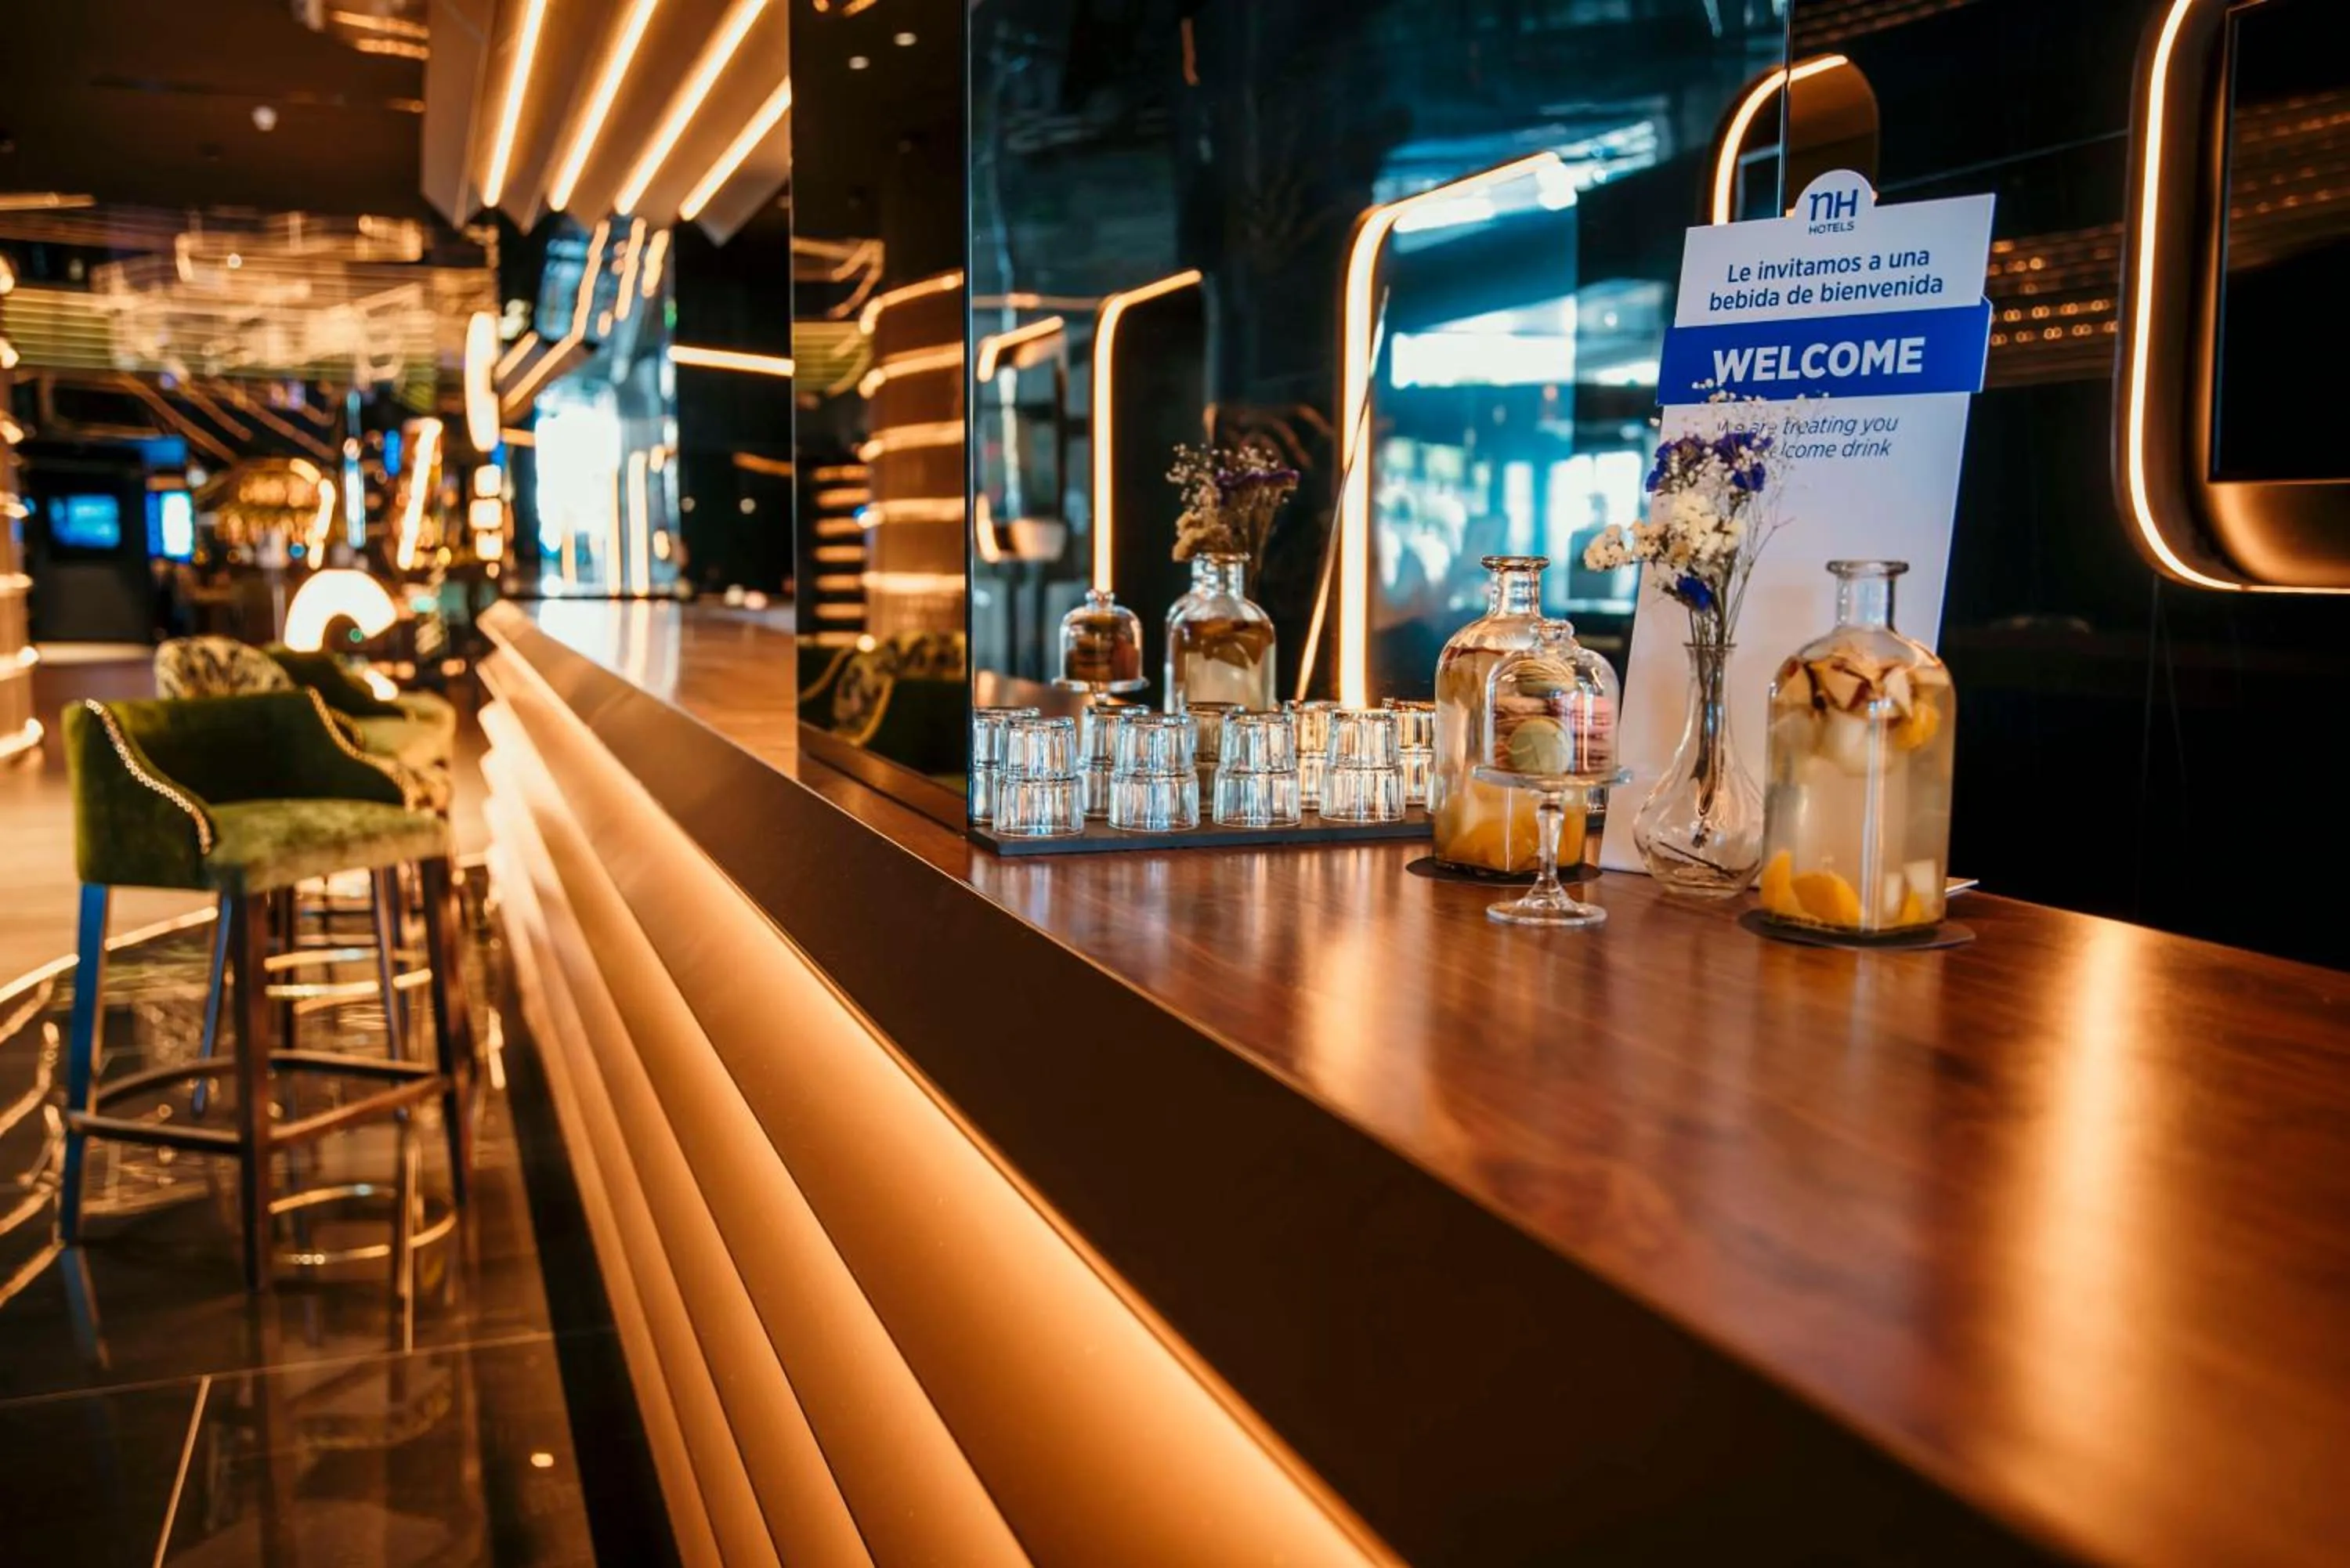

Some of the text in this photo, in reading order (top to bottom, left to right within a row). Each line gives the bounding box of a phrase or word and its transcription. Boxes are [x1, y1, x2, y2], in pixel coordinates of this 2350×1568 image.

[1809, 221, 1855, 234] HOTELS
[1727, 250, 1930, 283] Le invitamos a una
[1709, 274, 1943, 312] bebida de bienvenida
[1713, 337, 1925, 384] WELCOME
[1783, 417, 1857, 436] treating
[1860, 417, 1900, 436] you
[1766, 438, 1893, 458] lcome drink
